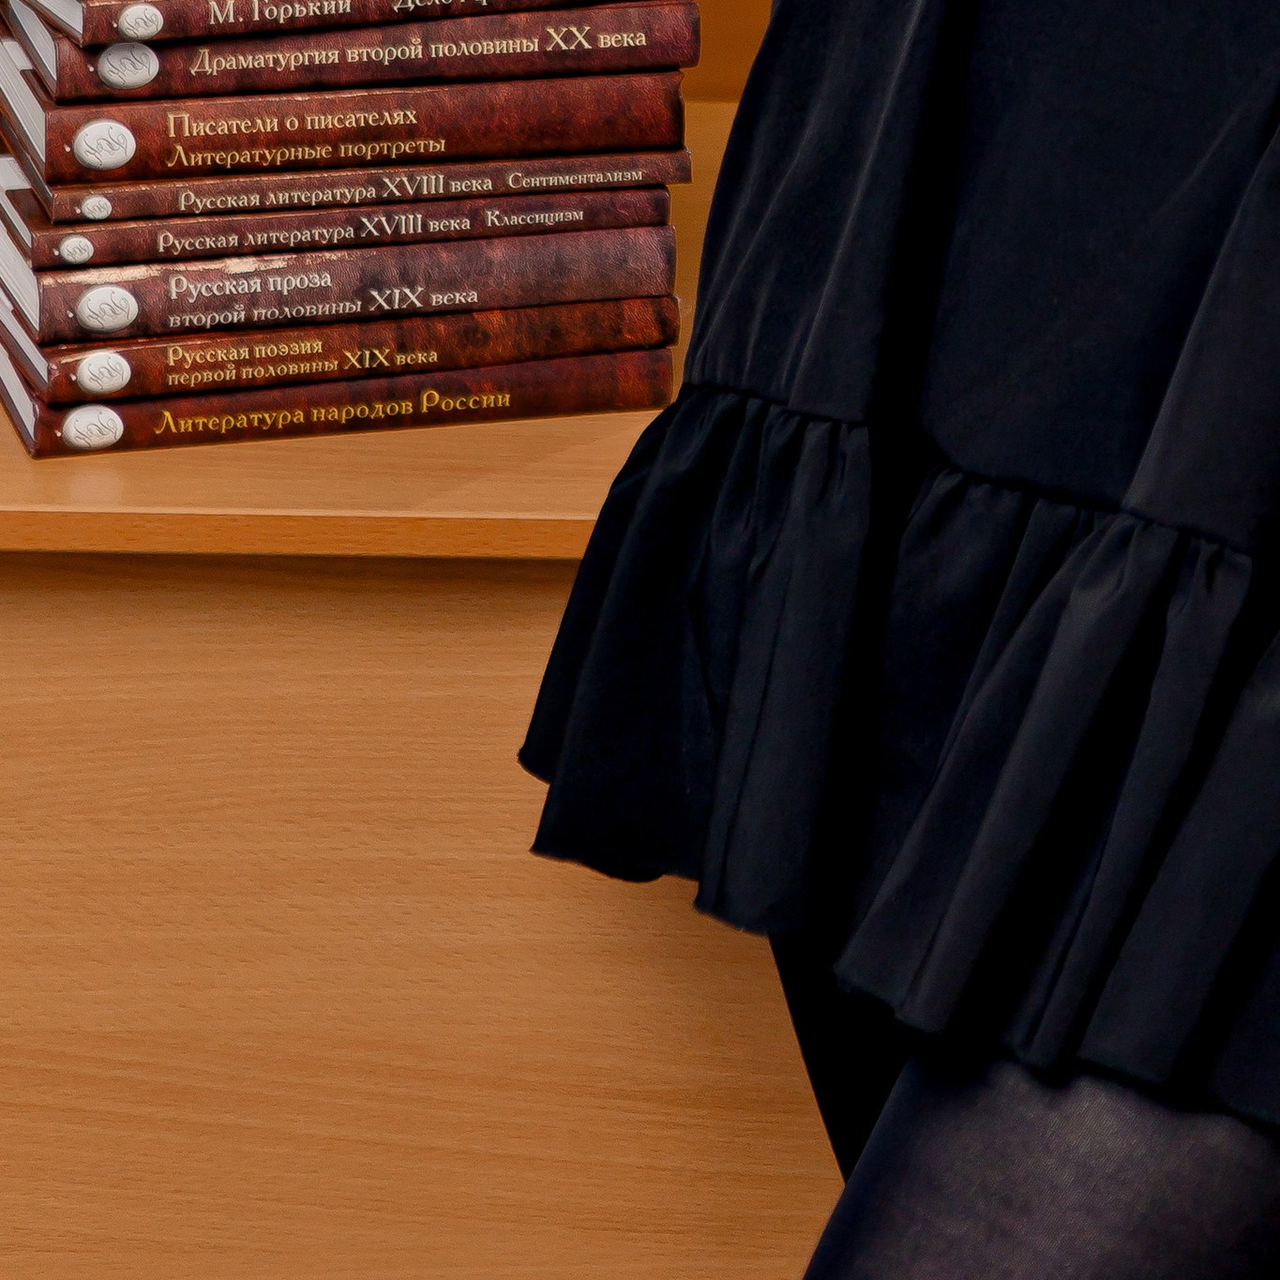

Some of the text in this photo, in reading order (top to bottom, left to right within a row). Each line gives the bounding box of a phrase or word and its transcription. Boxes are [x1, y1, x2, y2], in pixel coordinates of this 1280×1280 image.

[209, 0, 244, 25] М.
[190, 48, 339, 76] Драматургия
[347, 38, 423, 65] второй
[430, 38, 540, 58] половины
[597, 32, 647, 49] века
[168, 110, 418, 137] Писатели о писателях
[167, 138, 446, 169] Литературные портреты
[180, 174, 493, 214] Русская литература XVIII века
[509, 170, 643, 189] Сентиментализм
[486, 209, 584, 227] Классицизм
[158, 213, 471, 255] Русская литература XVIII века
[169, 272, 332, 303] Русская проза
[169, 287, 479, 329] второй половины XIX века
[167, 339, 323, 369] Русская поэзия
[167, 348, 438, 387] первой половины XIX века
[154, 389, 511, 435] Литература народов России
